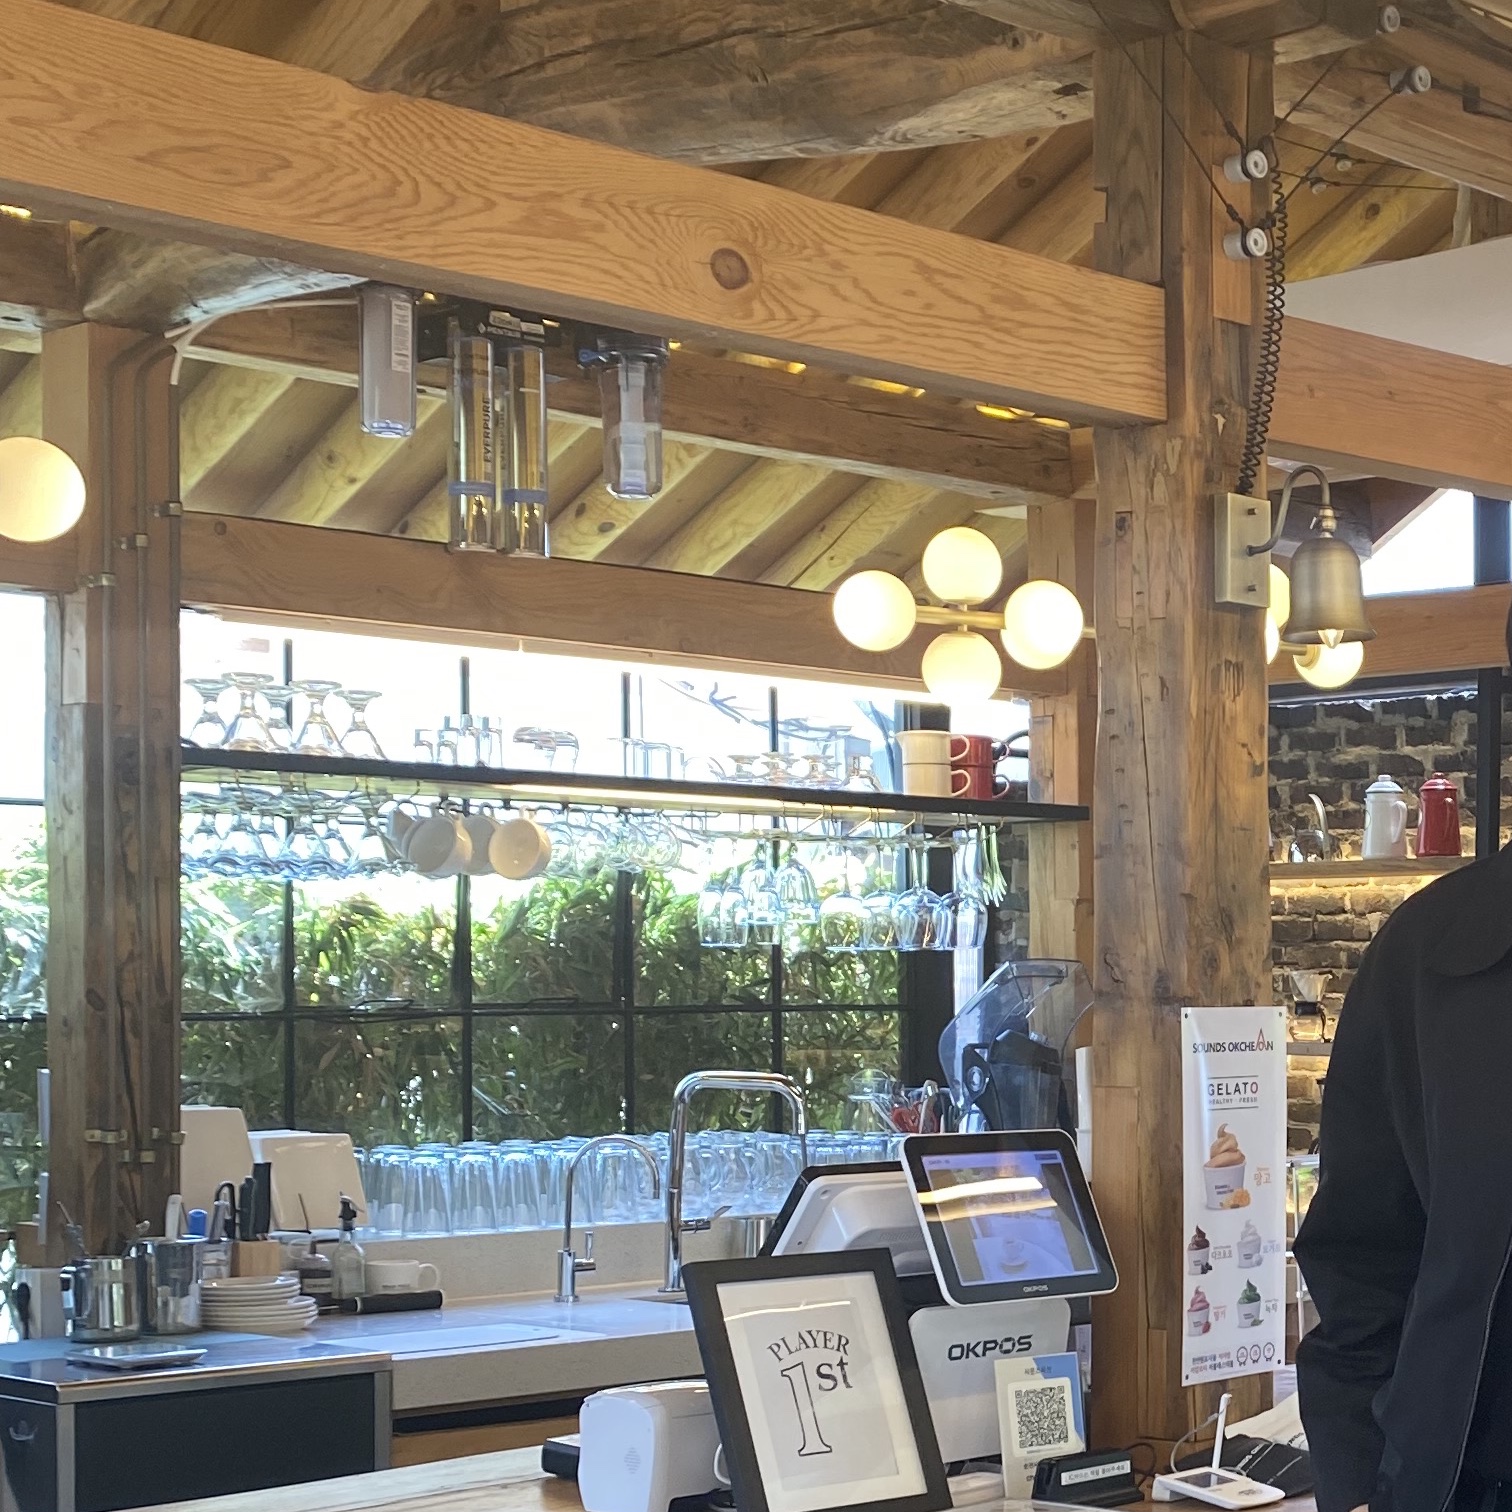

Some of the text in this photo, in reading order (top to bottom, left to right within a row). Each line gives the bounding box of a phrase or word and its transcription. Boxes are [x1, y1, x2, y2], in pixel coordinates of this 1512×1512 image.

[482, 393, 492, 463] EVERPURE
[1192, 1042, 1227, 1053] SOUNDS
[1208, 1082, 1259, 1096] GELATO
[1254, 1172, 1272, 1187] 망고
[1022, 1284, 1049, 1293] OKPOS
[767, 1329, 850, 1362] PLAYER
[948, 1334, 1033, 1361] OKPOS
